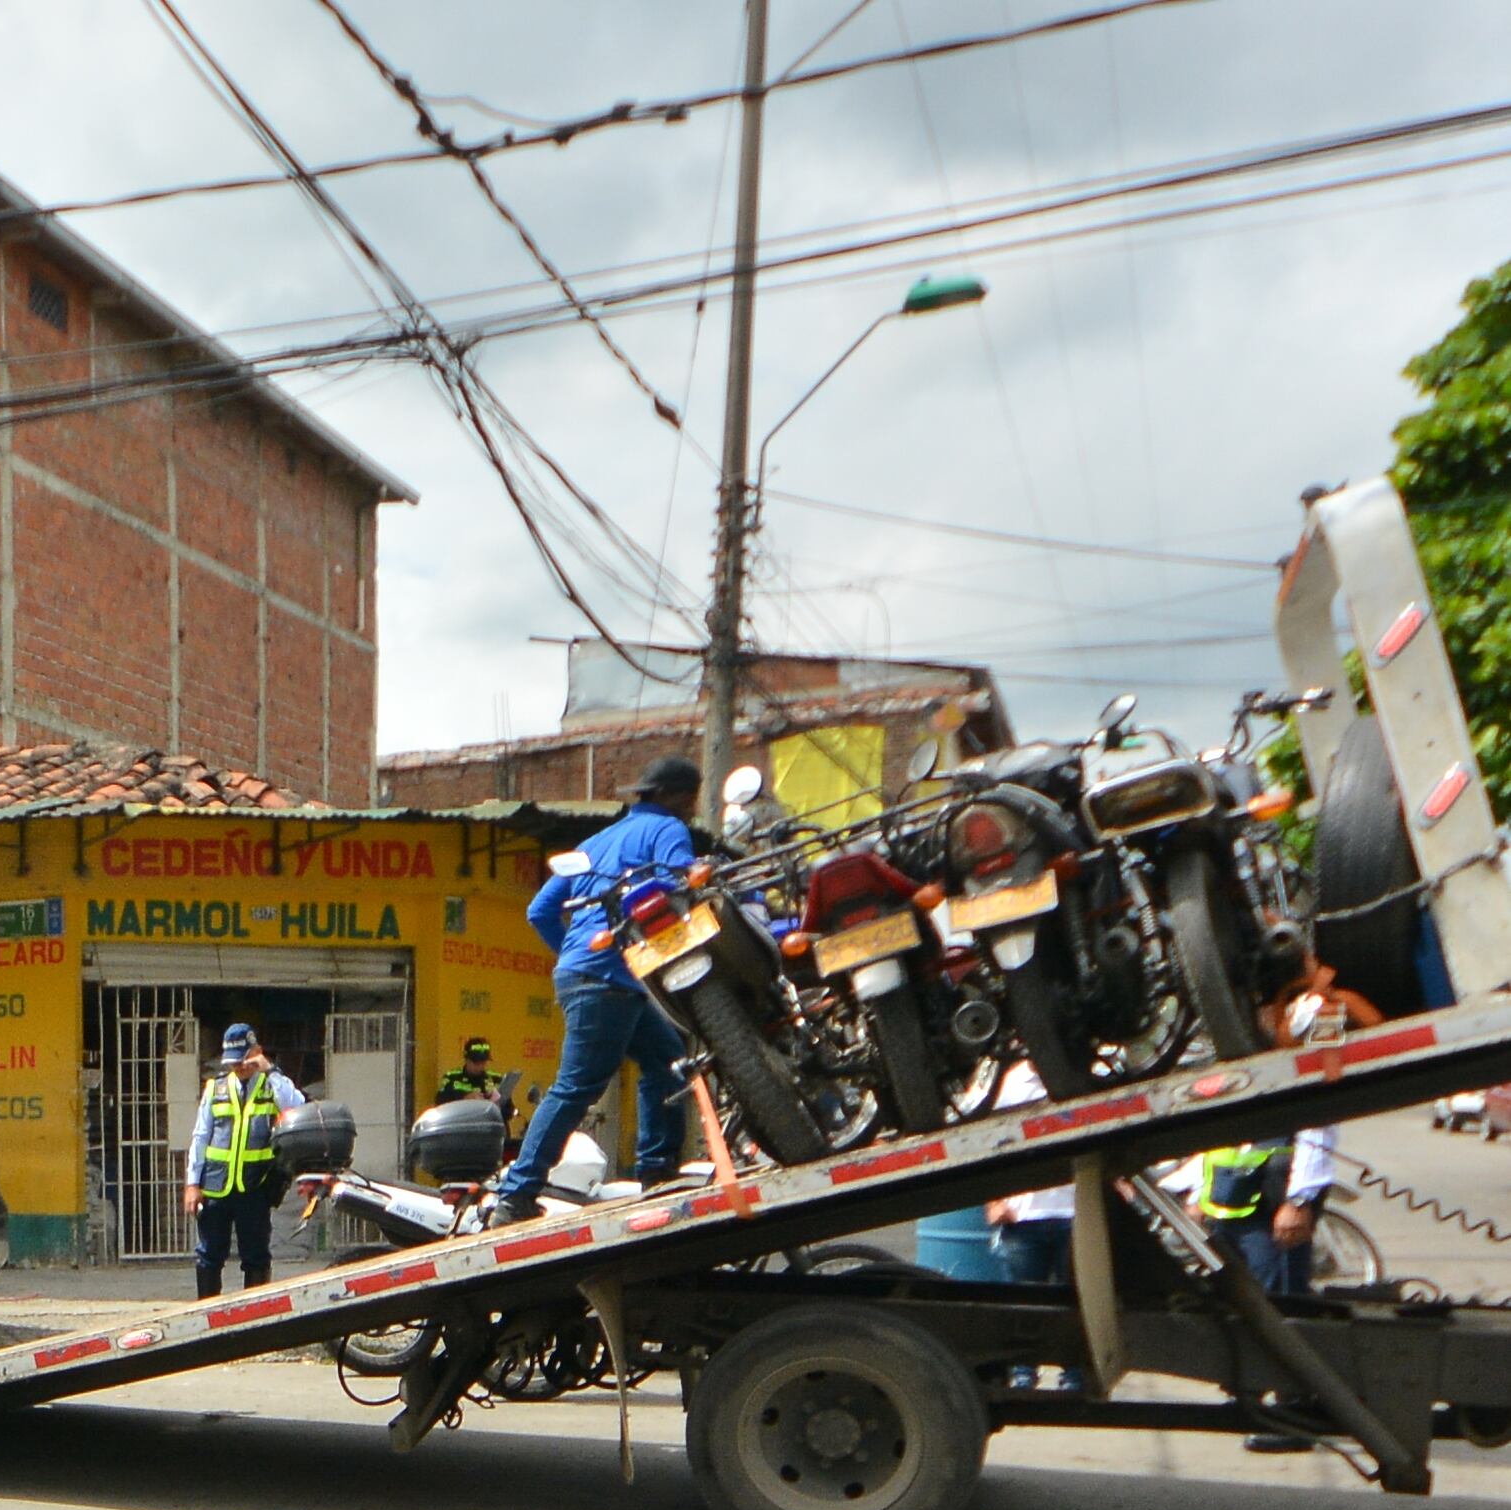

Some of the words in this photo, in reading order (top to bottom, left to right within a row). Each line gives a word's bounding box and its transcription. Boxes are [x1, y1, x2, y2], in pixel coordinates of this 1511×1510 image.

[101, 828, 280, 878] CEDEÑO
[295, 839, 436, 879] YUNDA
[87, 899, 250, 938] MARMOL
[280, 901, 400, 940] HUILA
